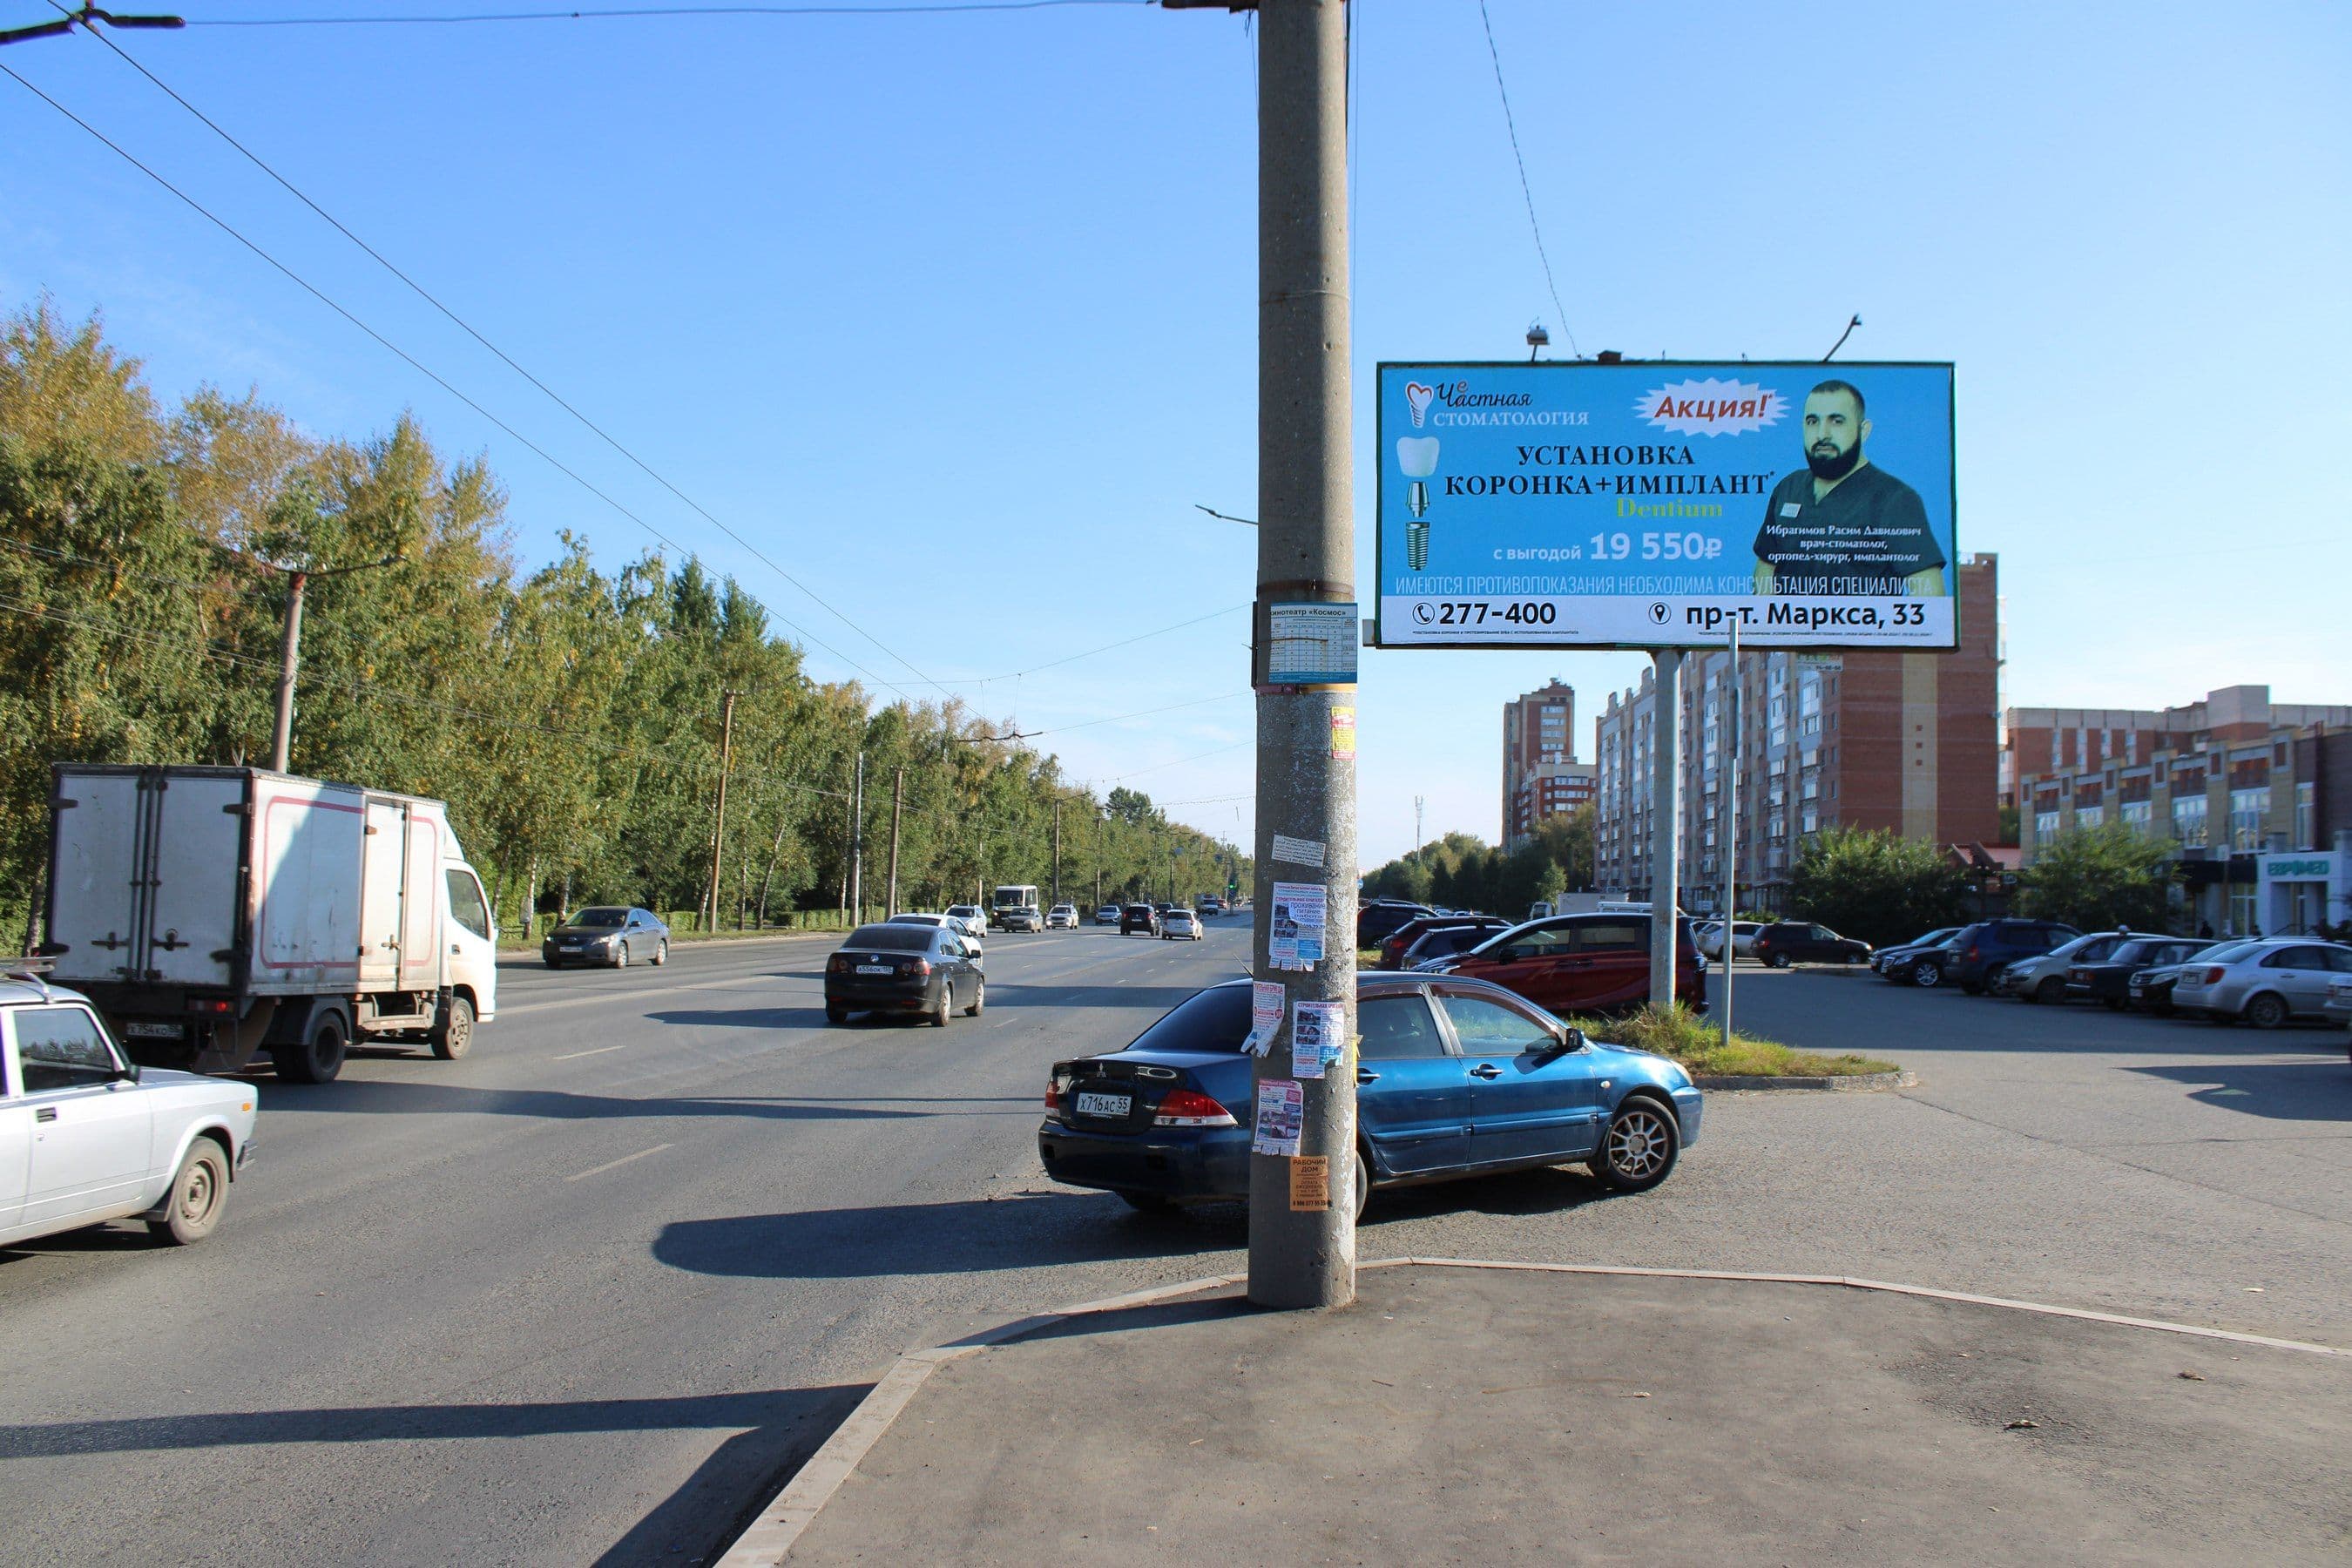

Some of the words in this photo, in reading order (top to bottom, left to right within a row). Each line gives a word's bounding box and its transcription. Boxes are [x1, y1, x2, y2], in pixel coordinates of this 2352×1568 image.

[1434, 411, 1589, 426] СТОМАТОЛОГИЯ
[1516, 445, 1695, 466] УСТАНОВКА
[1616, 498, 1723, 518] Dentium
[1767, 524, 1825, 537] Ибрагимов
[1828, 525, 1861, 536] Расим
[1863, 525, 1921, 536] Давидович
[1493, 549, 1503, 561] с
[1507, 544, 1581, 564] выгодой
[1591, 532, 1630, 560] 19
[1800, 540, 1889, 551] врач-стоматолог,
[1854, 553, 1921, 563] имплантолог
[1396, 577, 1462, 594] ИМЕЮТСЯ
[1467, 576, 1612, 594] ПРОТИВОПОКАЗАНИЯ
[1620, 576, 1713, 595] НЕОБХОДИМА
[1718, 576, 1828, 595] КОНСУЛЬТАЦИЯ
[1832, 577, 1933, 594] СПЕЦИАЛИСТА
[1439, 603, 1556, 625] 277-400
[1686, 605, 1758, 629] пр-т.
[1767, 603, 1884, 629] Маркса,
[1893, 604, 1925, 625] 33
[1080, 1096, 1115, 1112] Х716АС
[1118, 1098, 1128, 1110] 55
